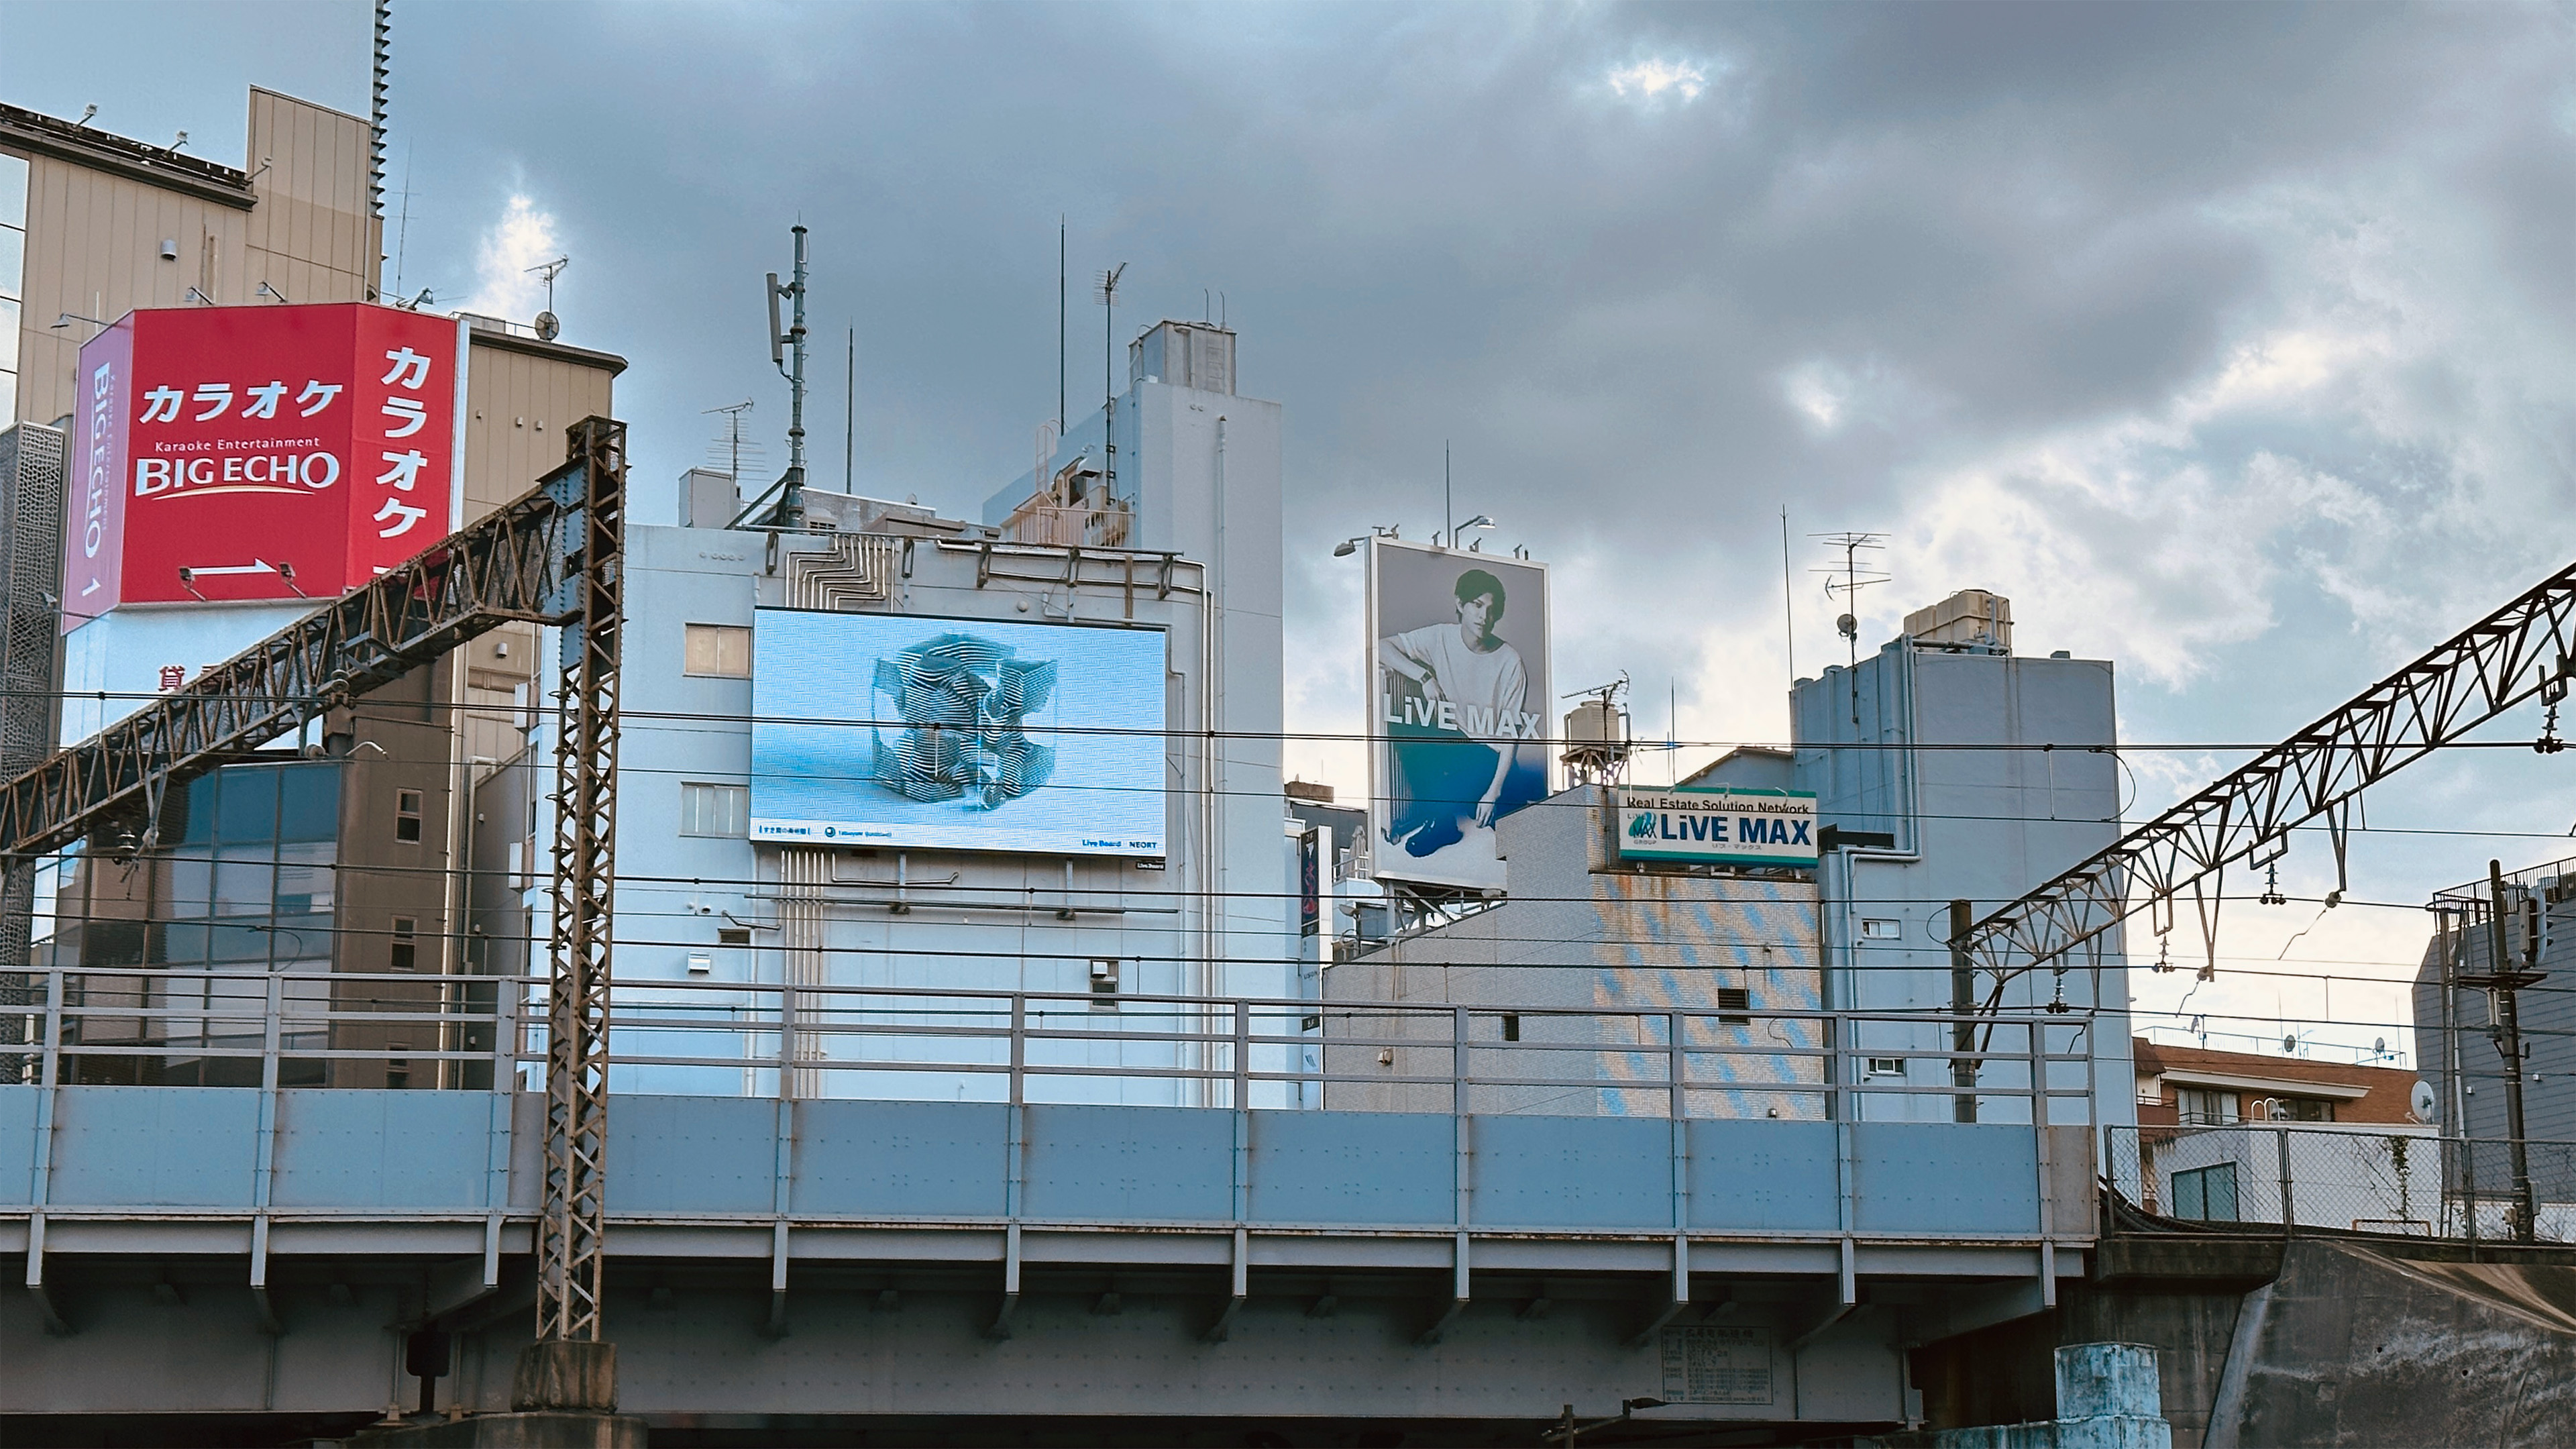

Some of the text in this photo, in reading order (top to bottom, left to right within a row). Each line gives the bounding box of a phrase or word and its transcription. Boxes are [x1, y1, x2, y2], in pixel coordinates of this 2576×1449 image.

[139, 379, 343, 424] カラオケ
[85, 362, 109, 558] BIG ECHO
[155, 437, 320, 452] Karaoke Entertainment
[372, 346, 431, 539] カラオケ
[136, 451, 339, 496] BIG ECHO
[1383, 693, 1541, 740] LiVE MAX
[1627, 796, 1809, 814] Real Estate Solution Network
[1661, 814, 1811, 846] LiVE MAX
